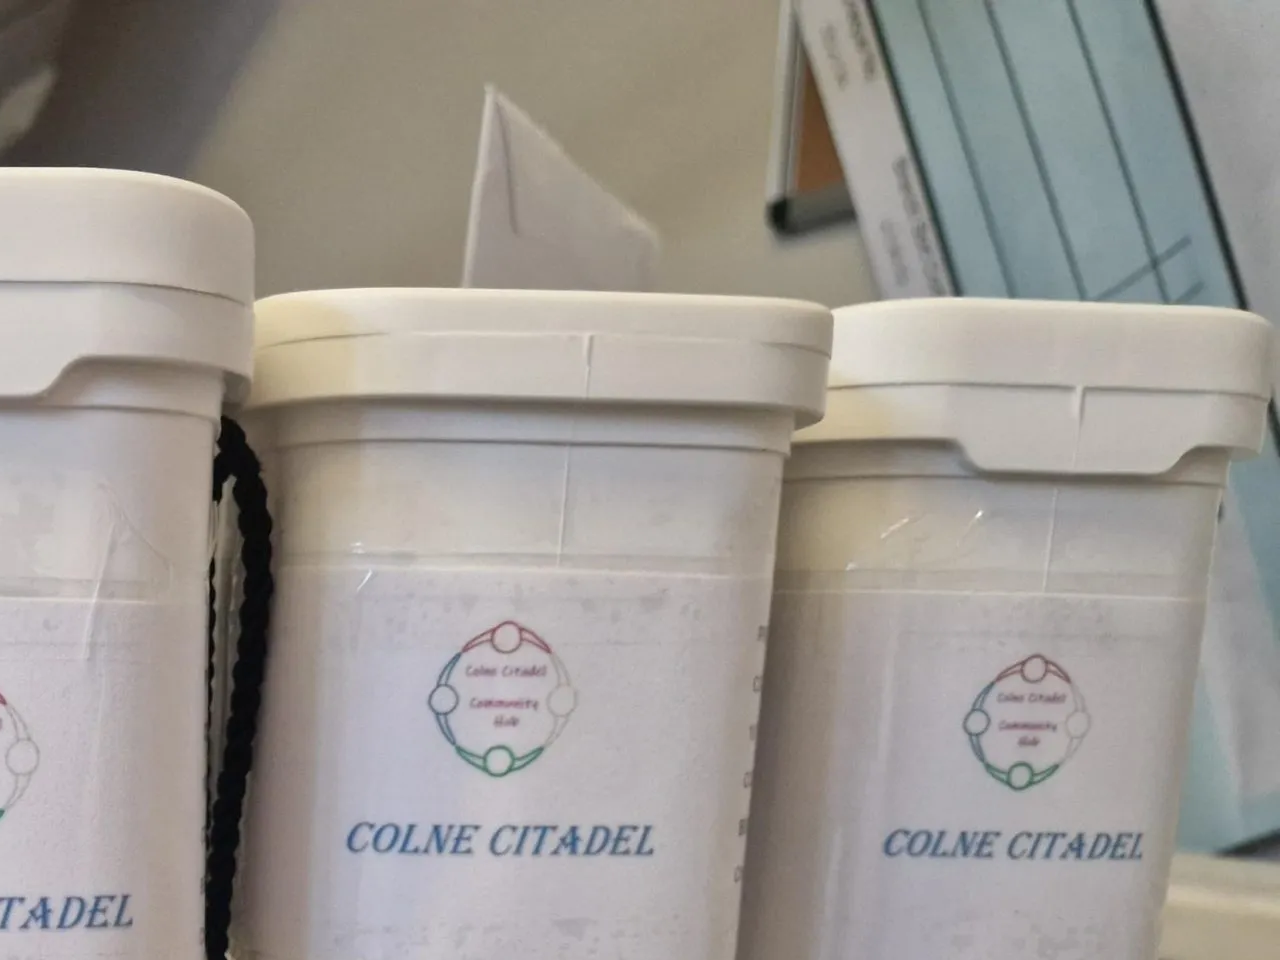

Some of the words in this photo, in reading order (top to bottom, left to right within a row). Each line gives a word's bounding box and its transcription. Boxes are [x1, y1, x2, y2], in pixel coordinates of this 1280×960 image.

[346, 821, 481, 855] COLNE
[488, 824, 655, 857] CITADEL
[881, 828, 1002, 859] COLNE
[1006, 831, 1144, 861] CITADEL
